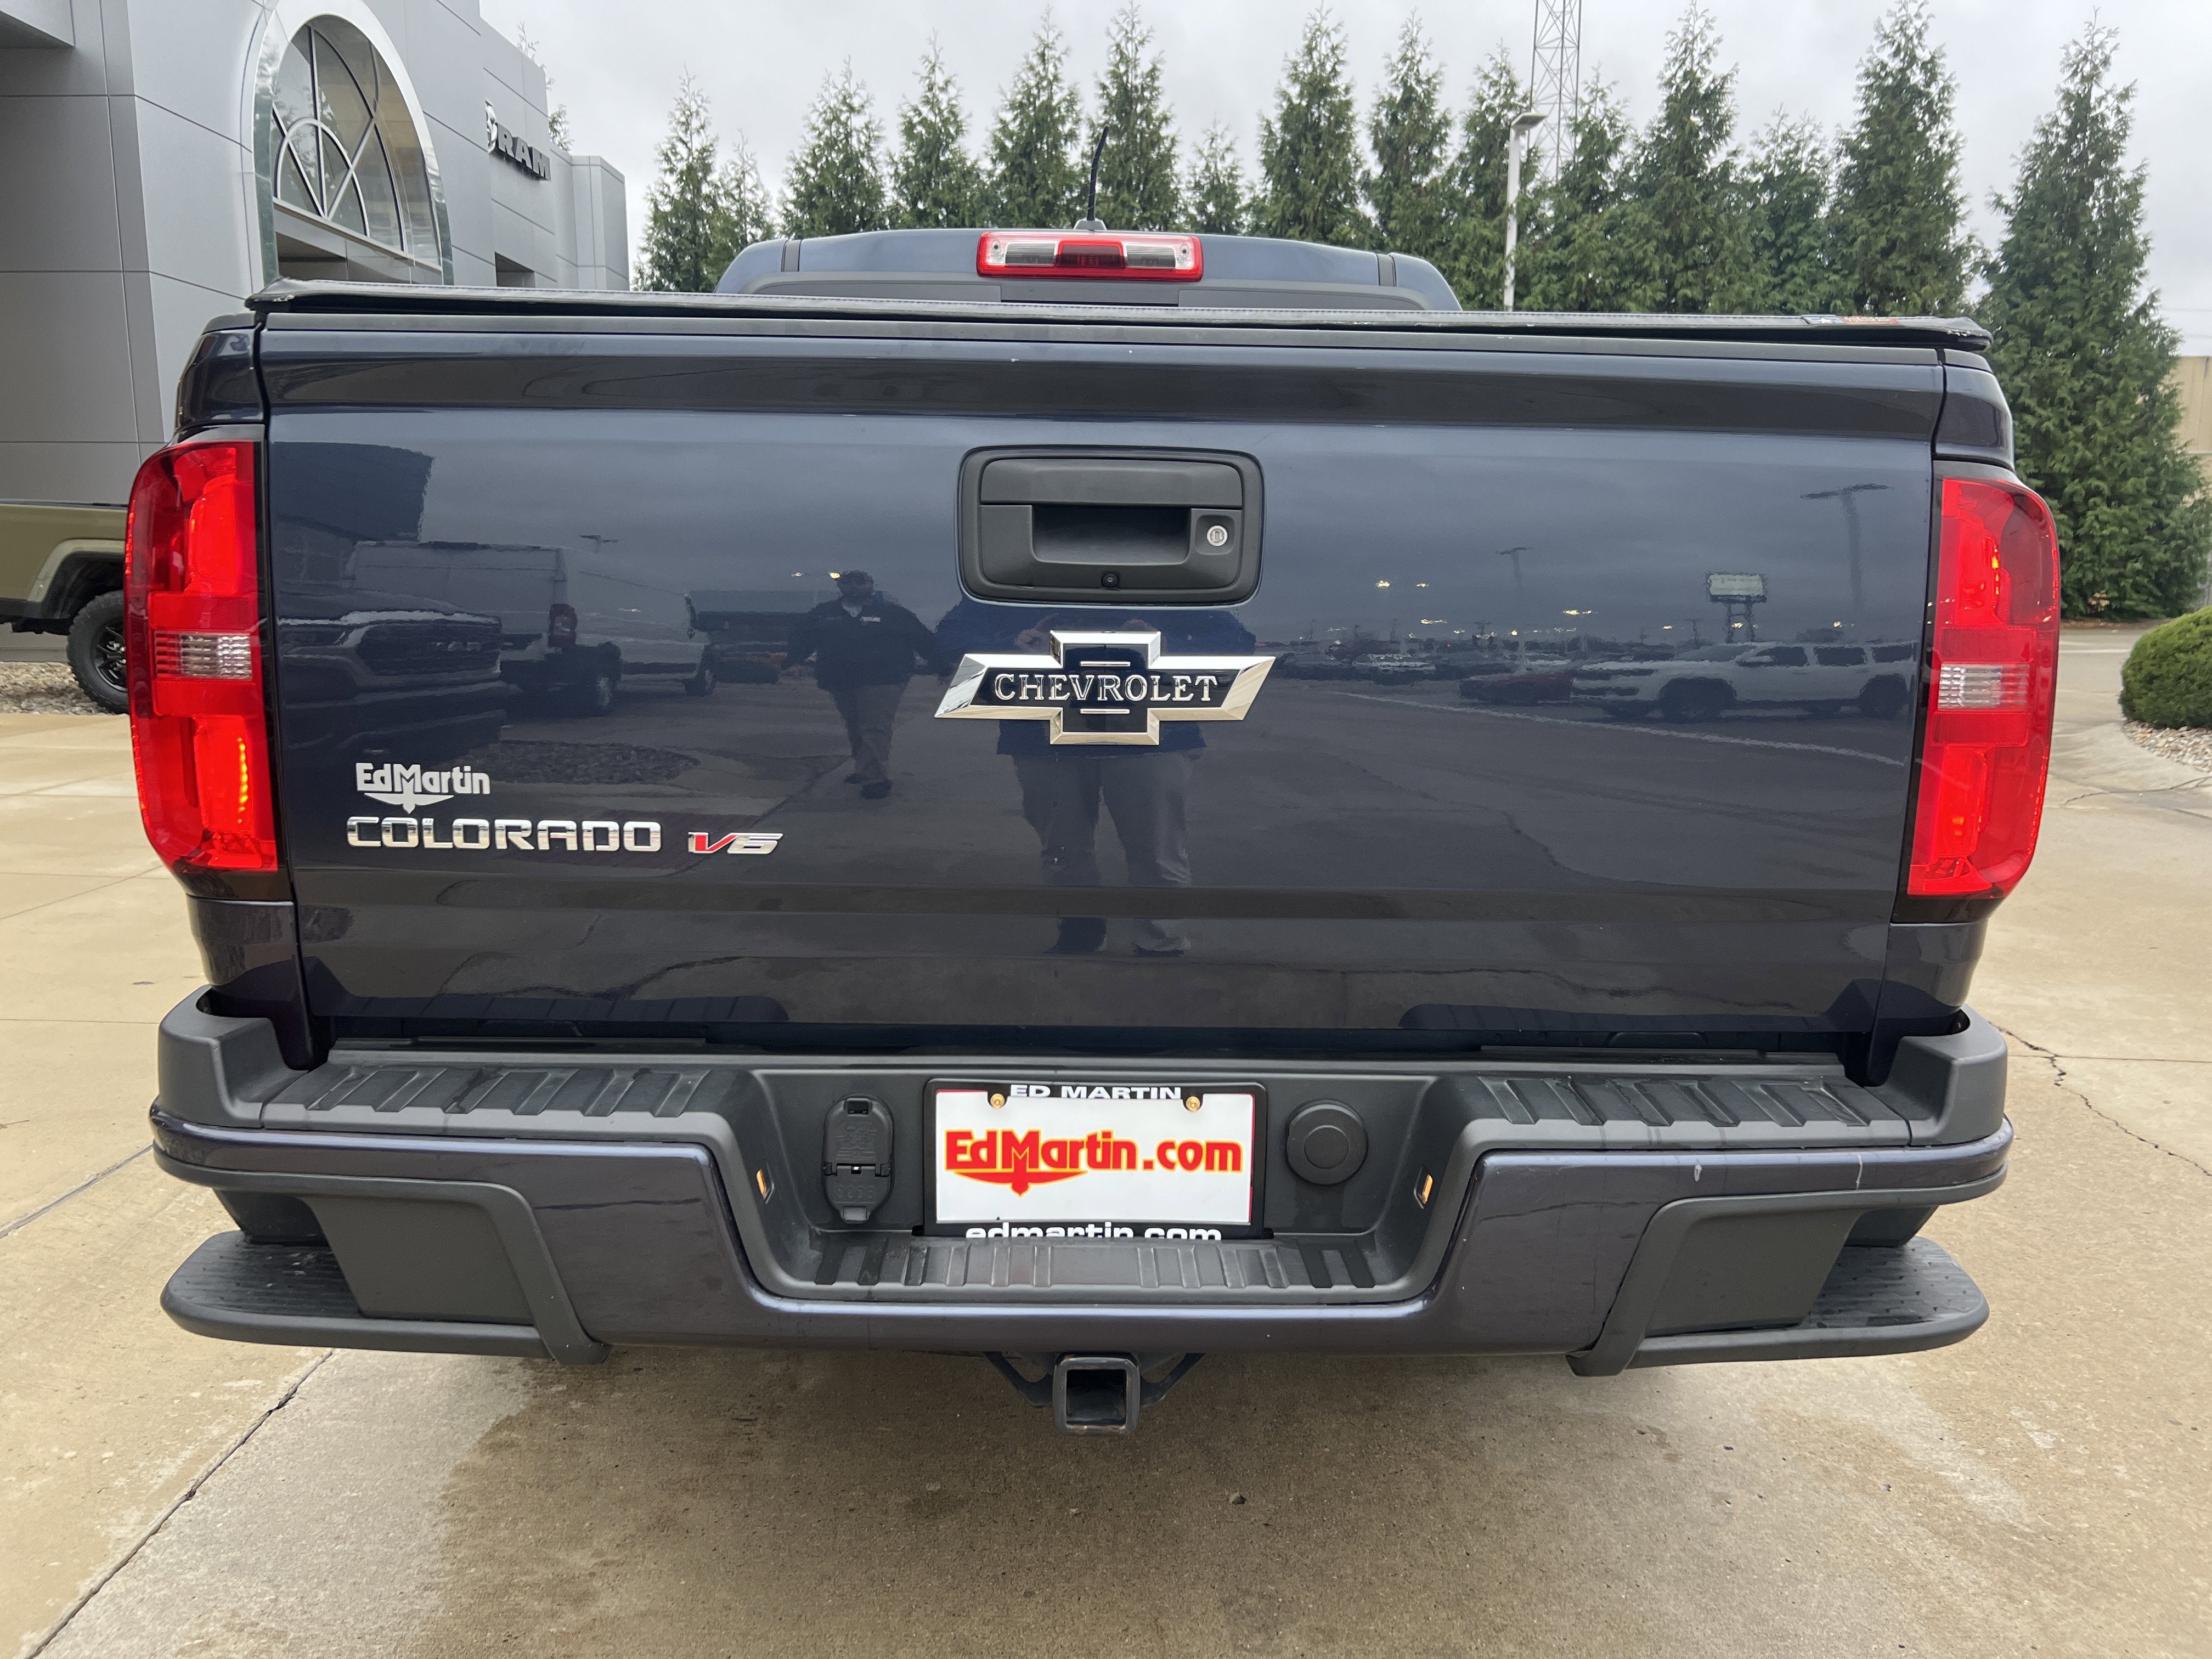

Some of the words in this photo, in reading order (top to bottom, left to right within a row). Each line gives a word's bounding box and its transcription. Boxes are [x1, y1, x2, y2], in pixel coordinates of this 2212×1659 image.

[495, 122, 551, 182] RAM
[994, 673, 1218, 702] CHEVROLET
[356, 762, 491, 795] EdMartin
[347, 816, 662, 853] COLORADO
[688, 832, 784, 854] V6
[1010, 1084, 1051, 1097] ED
[1061, 1086, 1181, 1099] MARTIN
[944, 1128, 1244, 1173] EdMartin.com
[966, 1221, 1222, 1240] edmartincom
